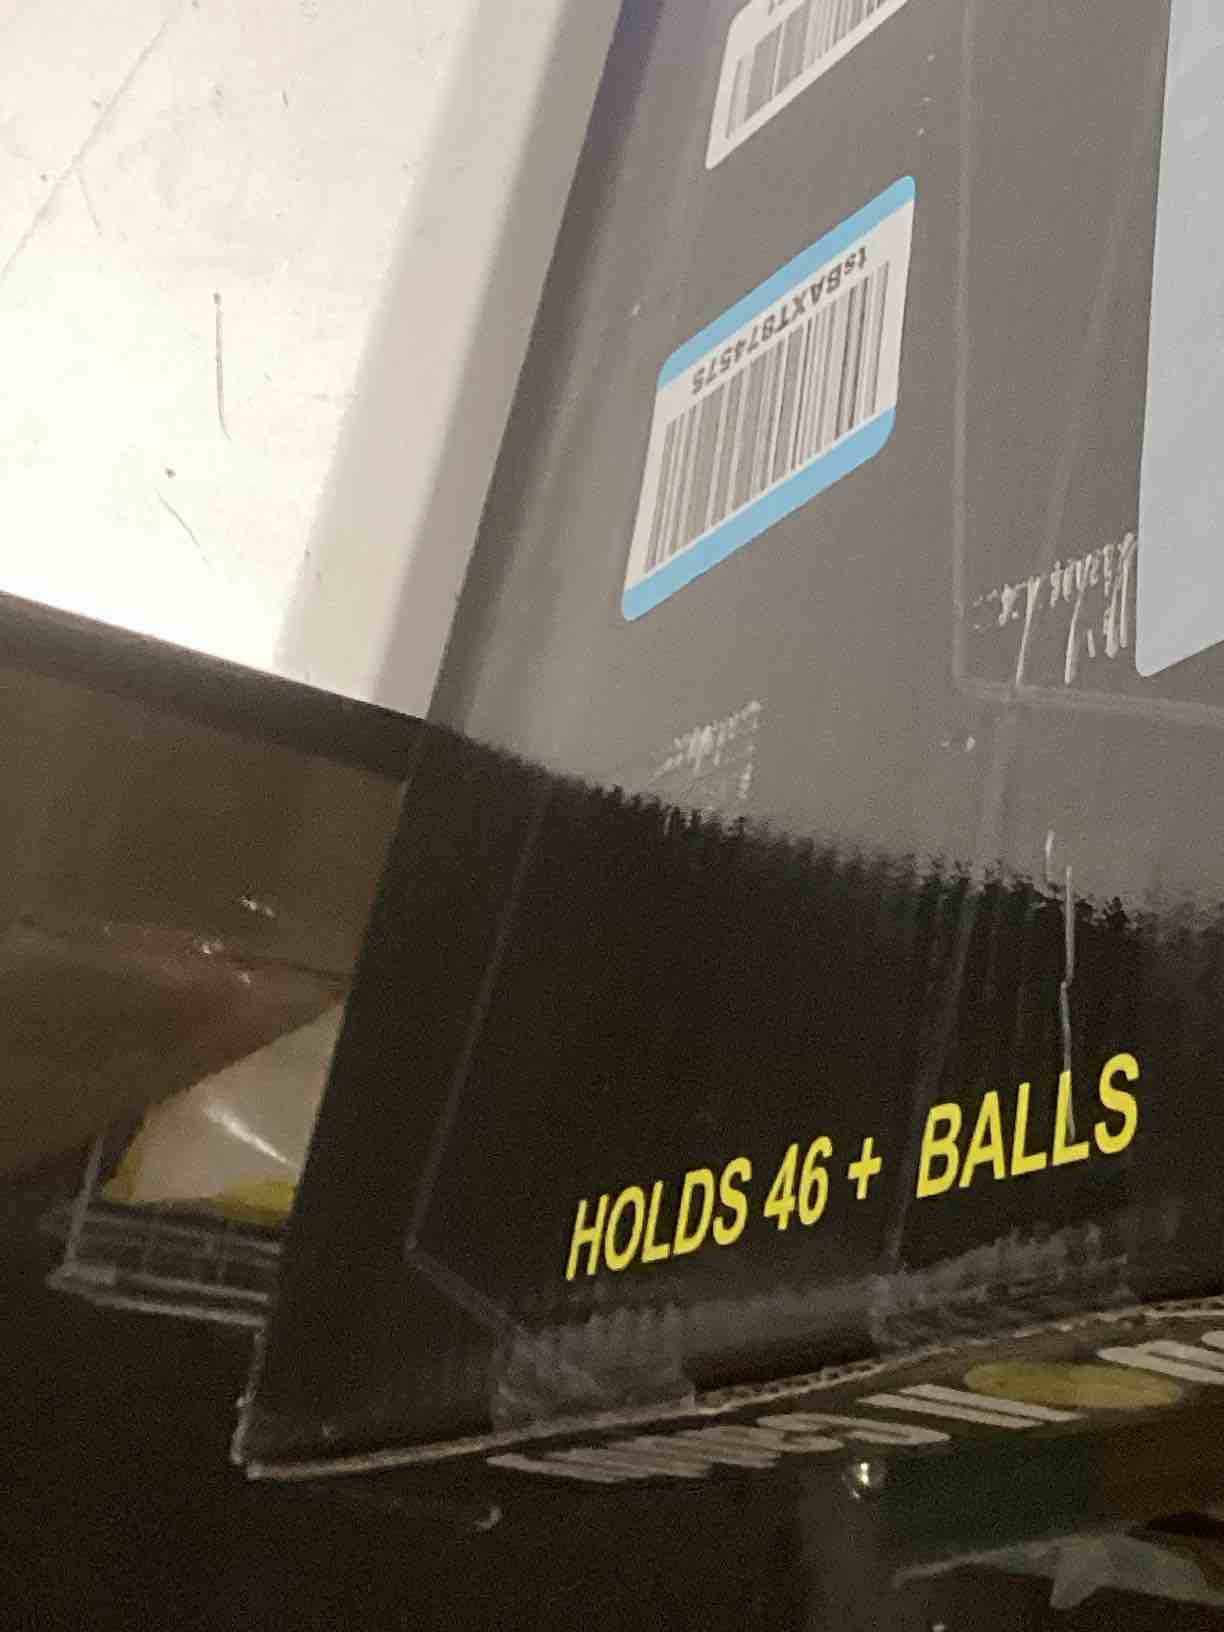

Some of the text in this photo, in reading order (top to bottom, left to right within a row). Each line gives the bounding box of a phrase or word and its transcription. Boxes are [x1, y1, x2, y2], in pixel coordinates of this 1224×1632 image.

[565, 1156, 752, 1281] HOLDS
[763, 1135, 833, 1232] 46
[916, 1053, 1140, 1199] BALLS
